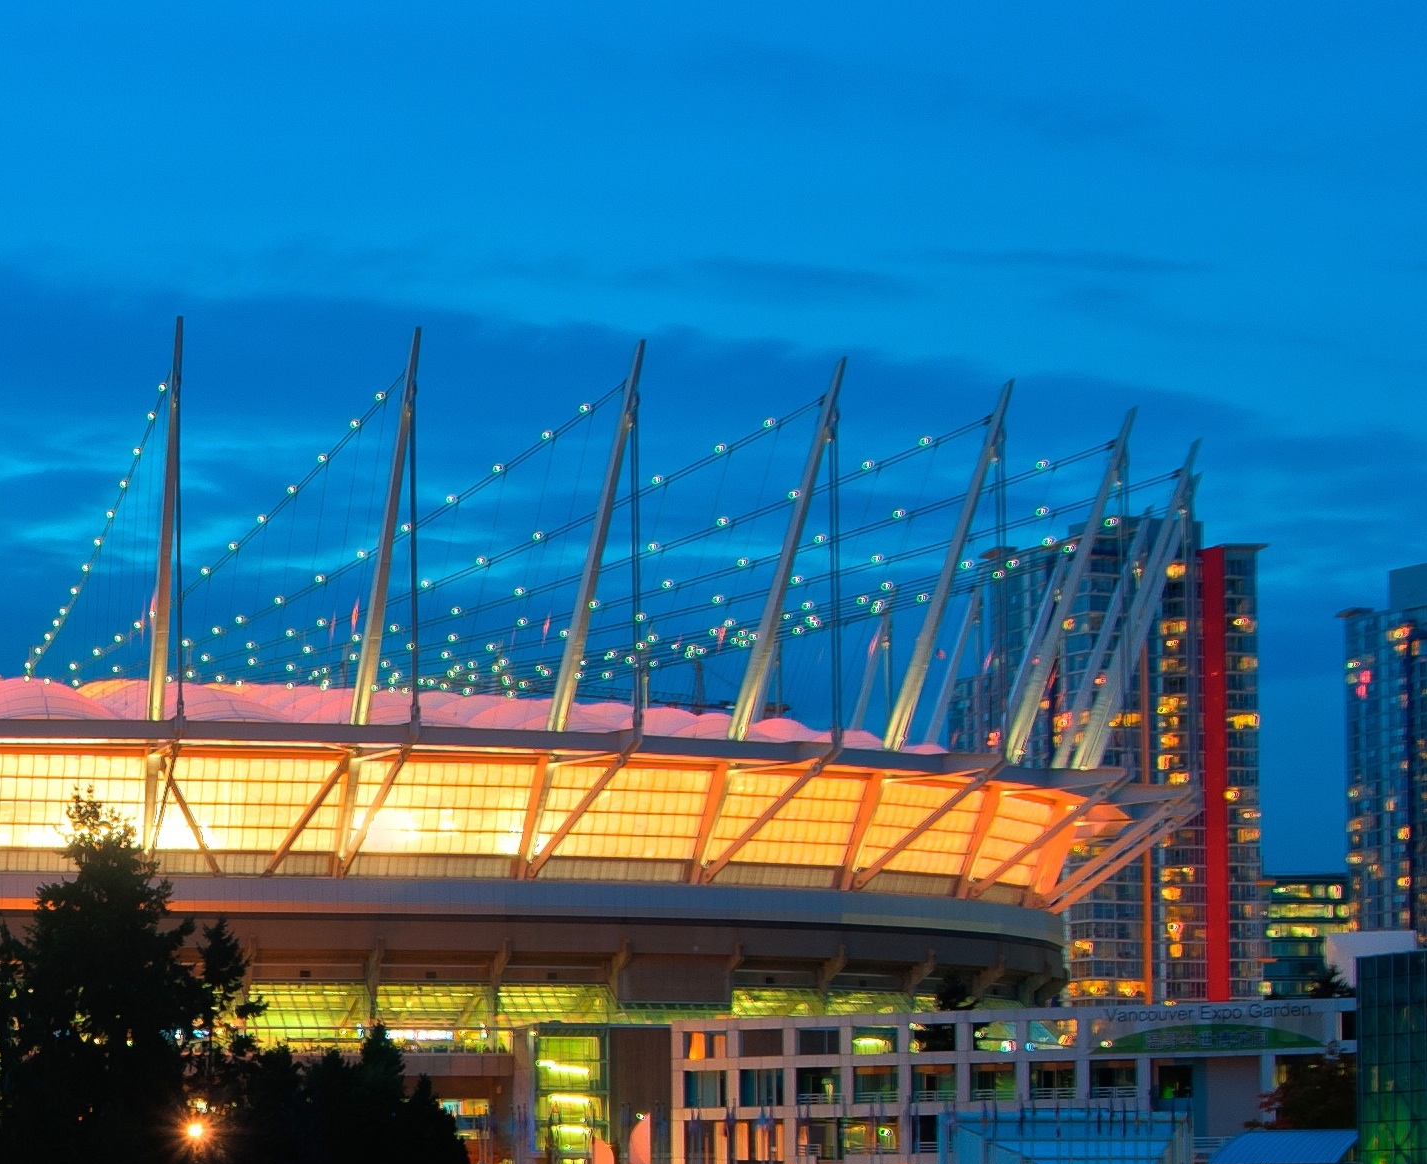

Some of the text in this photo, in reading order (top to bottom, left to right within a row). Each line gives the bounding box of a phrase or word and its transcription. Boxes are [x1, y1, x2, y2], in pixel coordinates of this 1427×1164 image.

[1105, 1003, 1312, 1023] Vancouver Expo Garden
